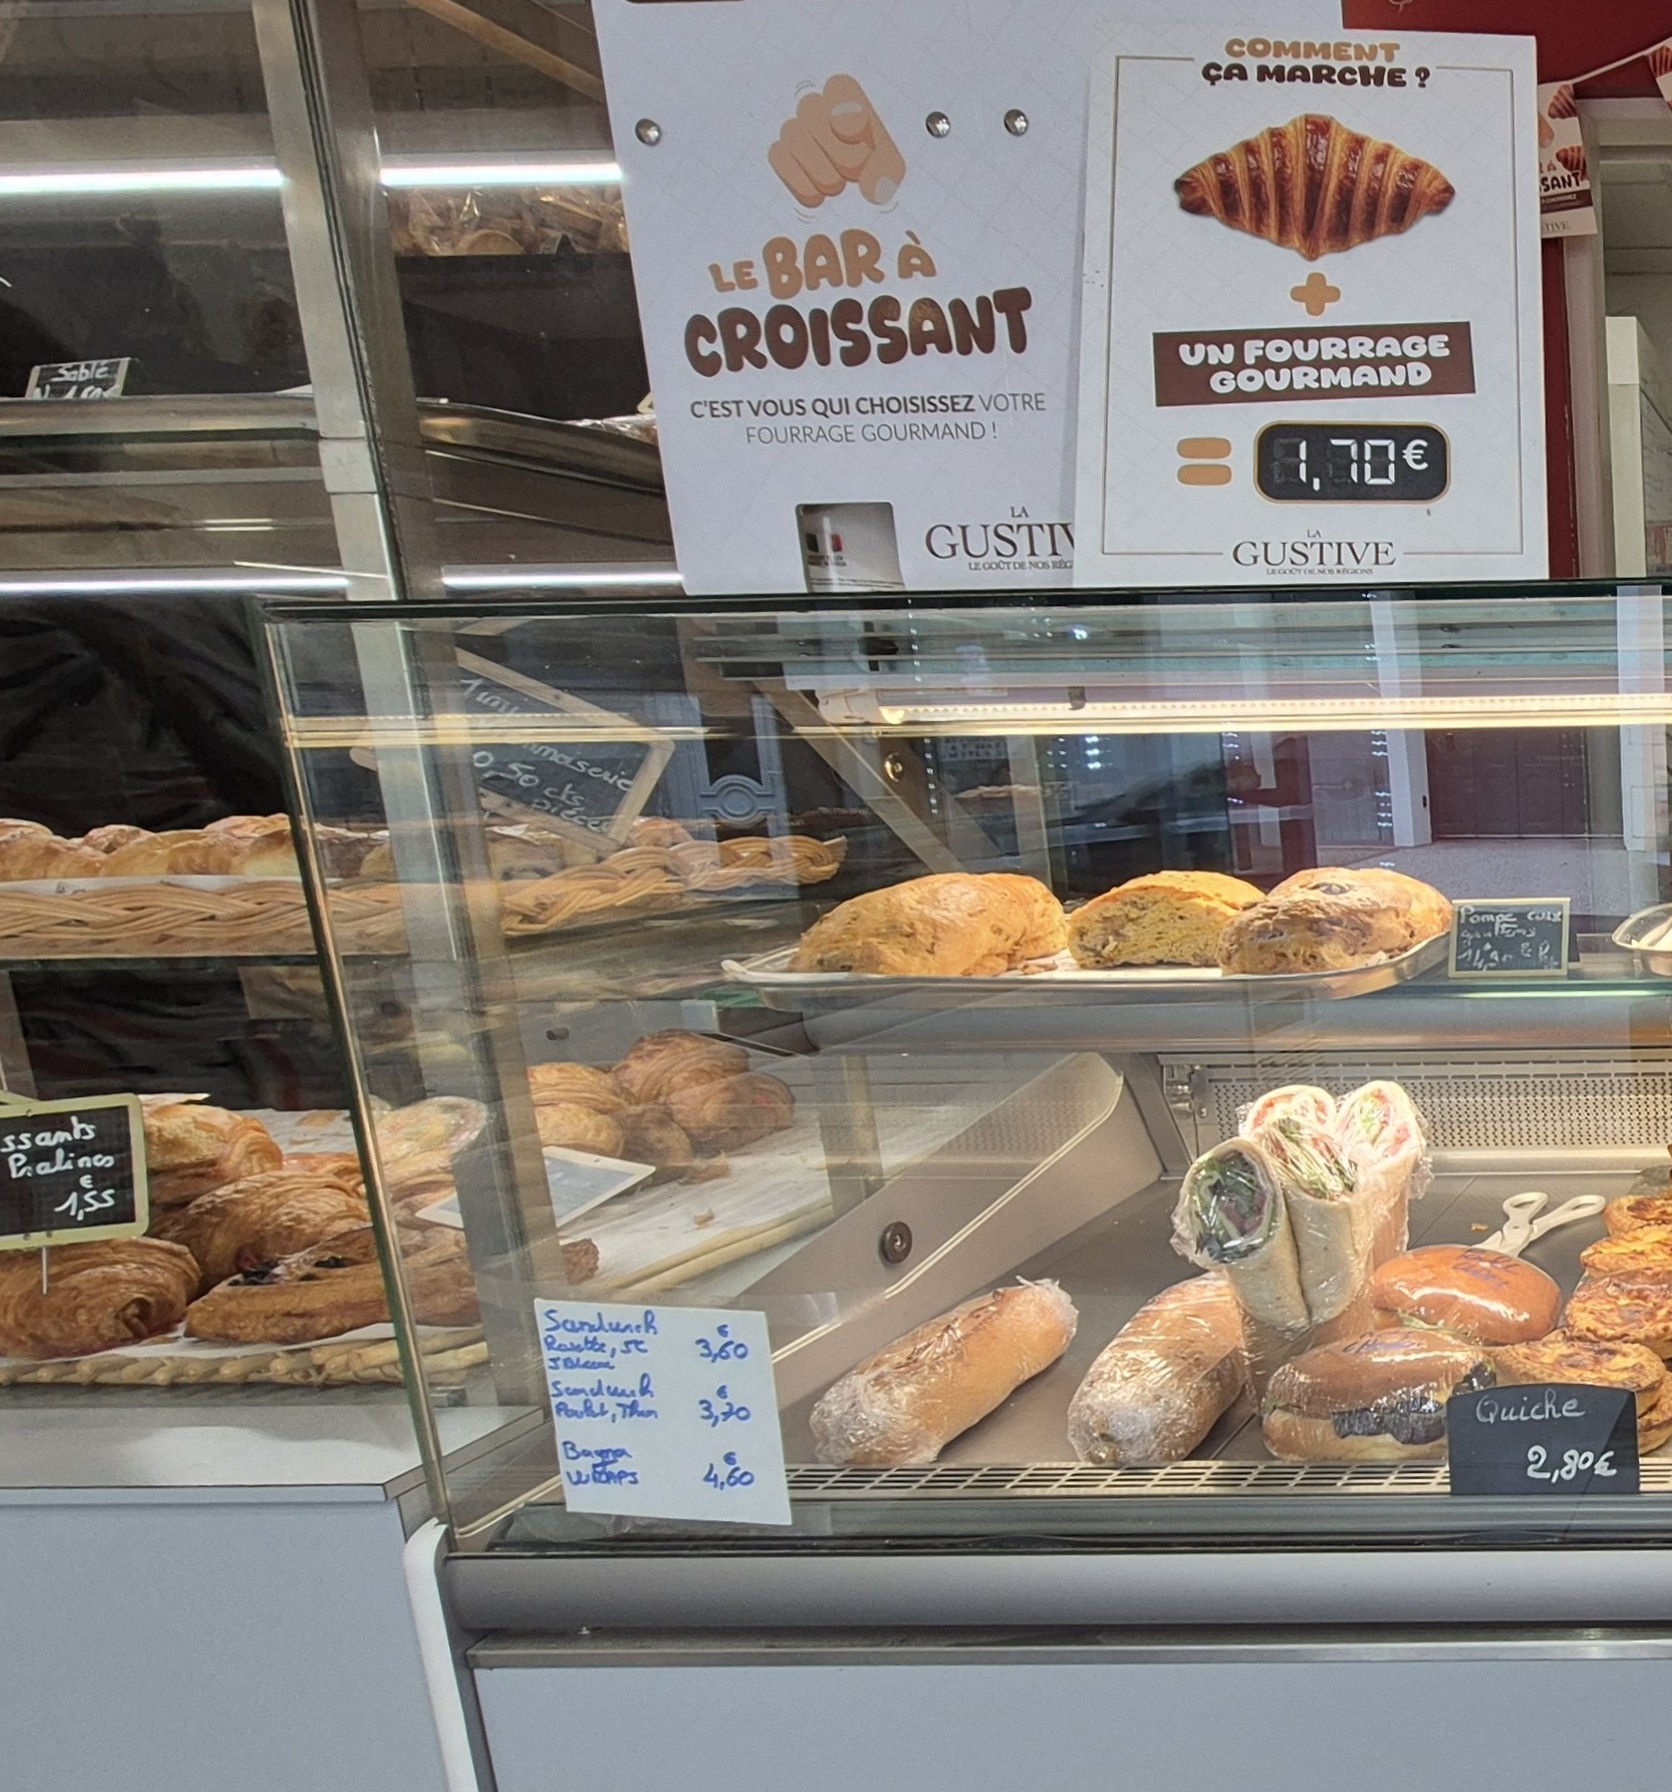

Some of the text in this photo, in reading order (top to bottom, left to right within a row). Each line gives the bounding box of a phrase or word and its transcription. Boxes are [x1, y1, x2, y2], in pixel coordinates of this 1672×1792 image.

[1225, 38, 1400, 62] COMMENT
[1201, 62, 1431, 88] ÇA MARCHE ?
[708, 229, 937, 300] LE BAR À
[684, 286, 1032, 377] CROISSANT
[1178, 334, 1450, 366] UN FOURRAGE
[1209, 362, 1432, 393] GOURMAND
[690, 393, 1047, 418] C'EST VOUS QUI CHOISISSEZ VOTRE
[746, 425, 855, 445] FOURRAGE
[861, 421, 986, 441] GOURMAND
[1010, 506, 1029, 518] LA
[1307, 530, 1322, 538] LA
[1232, 541, 1396, 567] GUSTIVE
[54, 1189, 115, 1221] 1,55
[695, 1338, 749, 1363] 3,60
[1475, 1391, 1586, 1424] Quiche
[703, 1463, 755, 1490] 4,60
[1526, 1445, 1617, 1483] 2,80€
